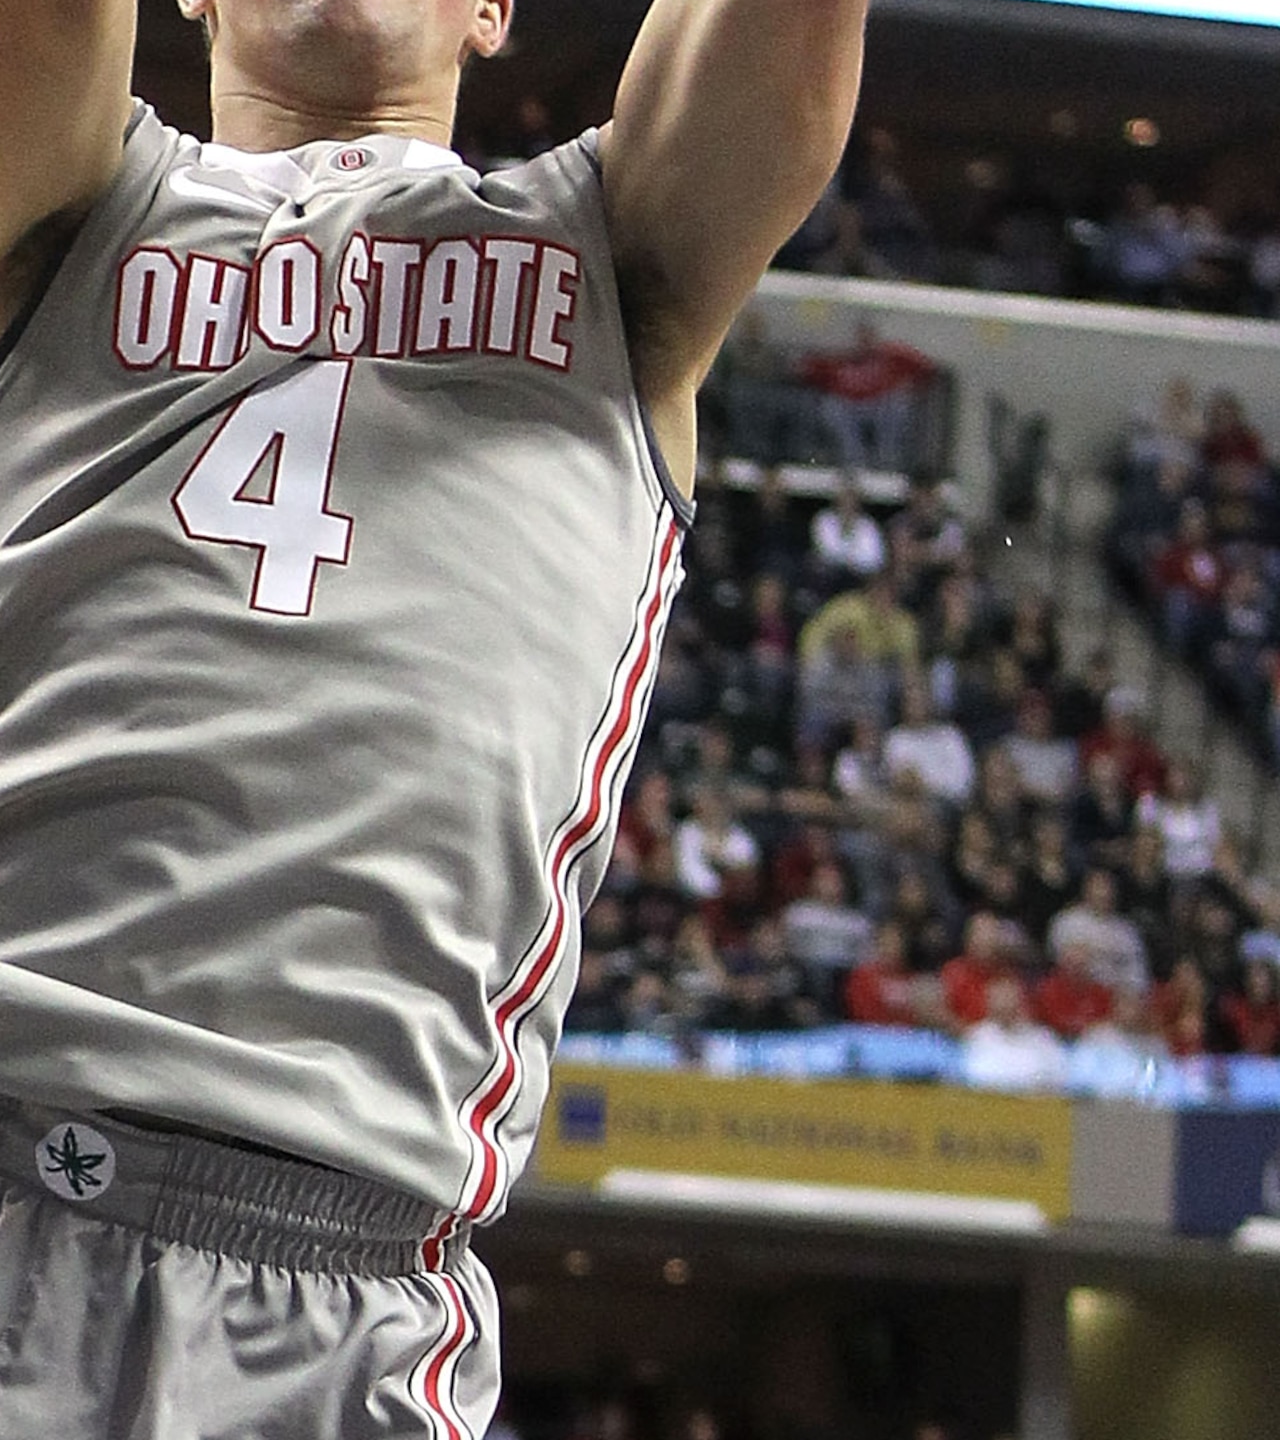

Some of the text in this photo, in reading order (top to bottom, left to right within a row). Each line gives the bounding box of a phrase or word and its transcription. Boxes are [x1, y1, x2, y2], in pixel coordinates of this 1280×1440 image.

[112, 231, 582, 372] OHO STATE
[172, 357, 354, 616] 4
